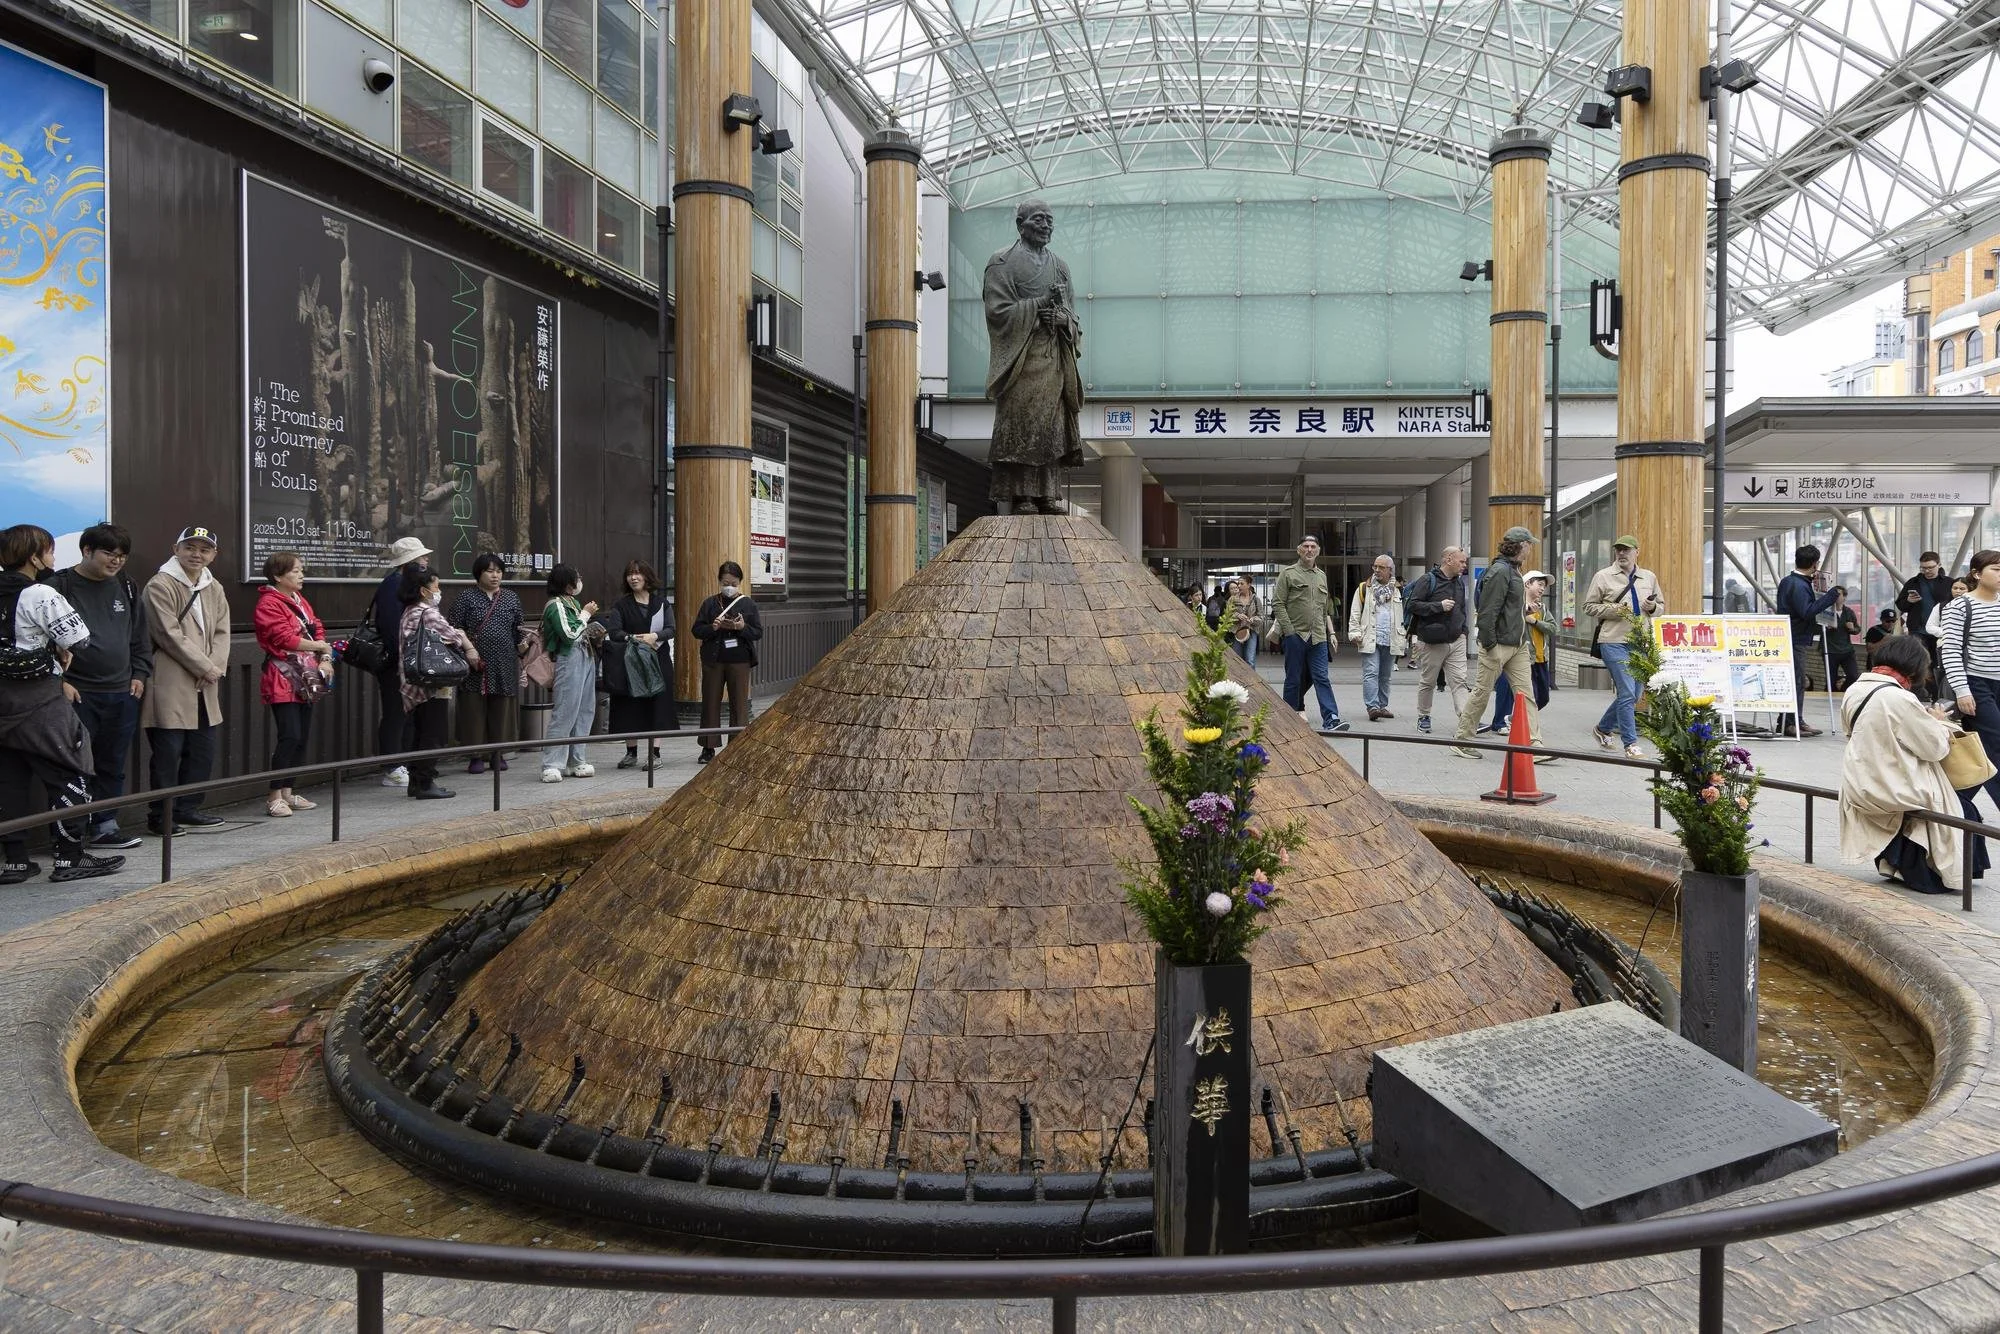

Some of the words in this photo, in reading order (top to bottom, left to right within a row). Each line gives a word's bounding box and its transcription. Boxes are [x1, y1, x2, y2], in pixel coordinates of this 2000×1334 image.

[451, 262, 478, 420] ANDO
[270, 381, 300, 403] The
[271, 403, 345, 433] Promised
[1106, 410, 1133, 424] 近鉄
[1398, 420, 1442, 433] NARA
[271, 426, 334, 455] Journey
[271, 450, 290, 467] of
[271, 470, 318, 492] Souls
[1798, 476, 1876, 489] 近鉄線のりば
[1798, 490, 1842, 500] Kintetsu
[1845, 490, 1868, 500] Line
[1661, 622, 1717, 647] 献血
[1739, 639, 1766, 648] ご協力
[1728, 648, 1780, 658] お願いします
